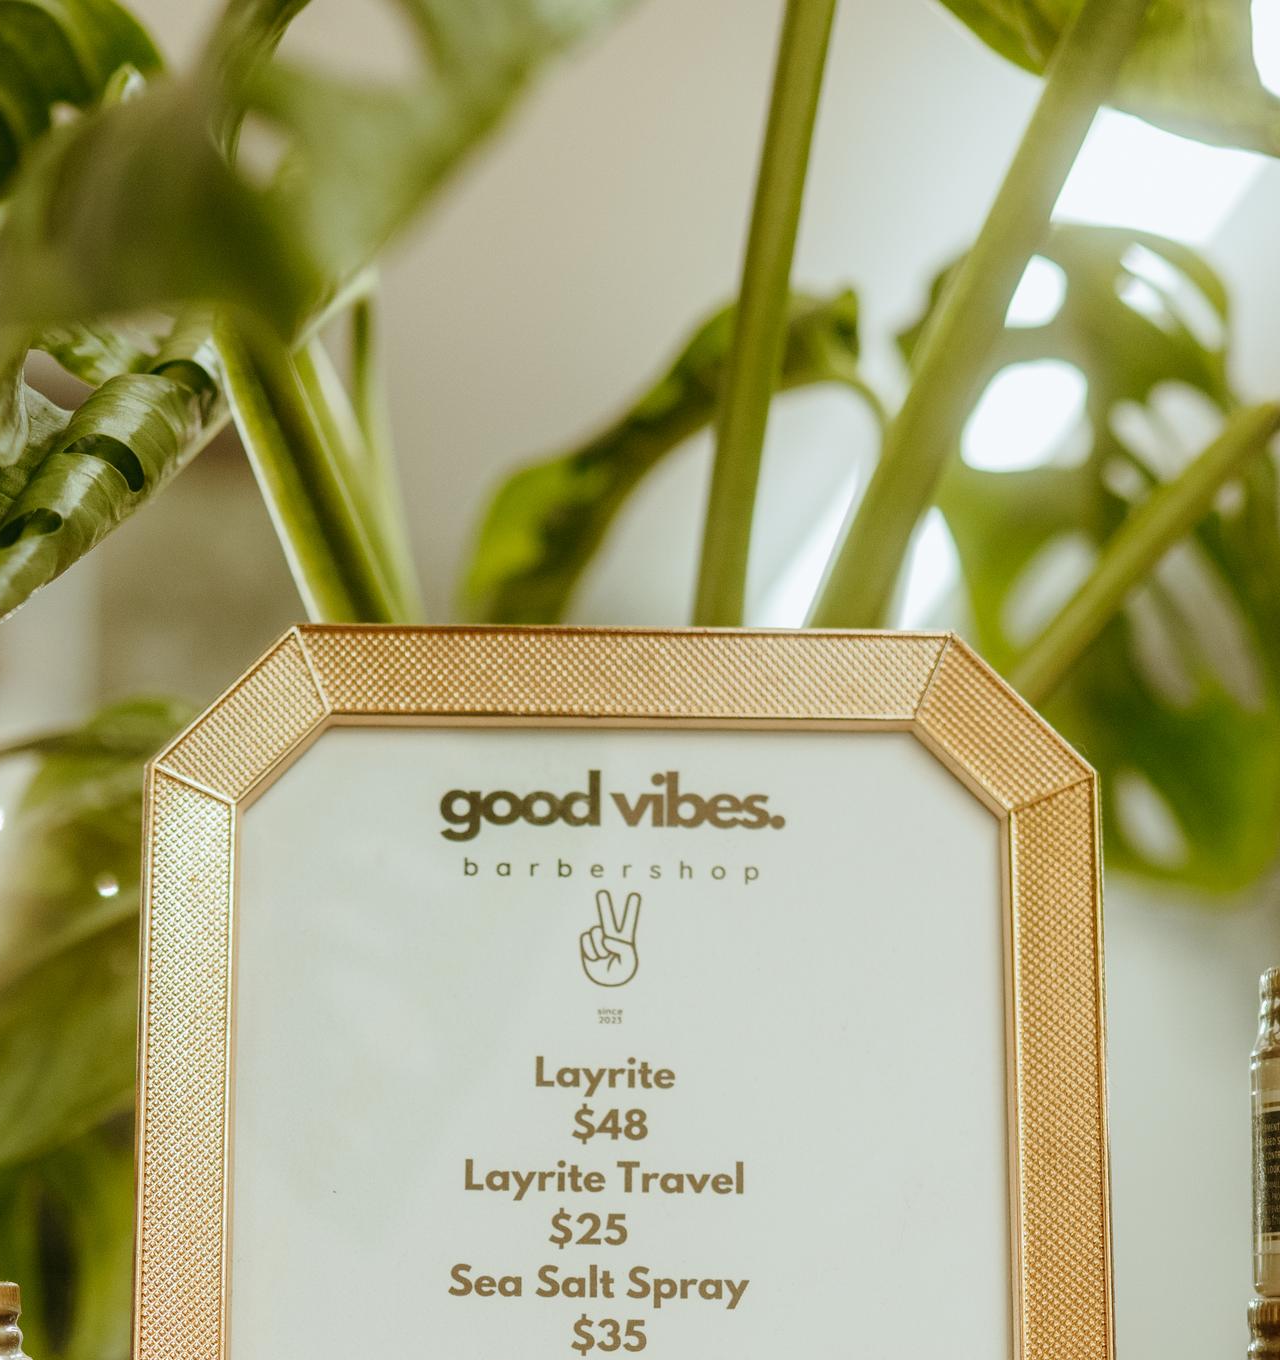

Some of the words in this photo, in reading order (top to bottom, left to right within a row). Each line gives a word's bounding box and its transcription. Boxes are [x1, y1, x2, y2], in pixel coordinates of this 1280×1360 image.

[440, 770, 601, 842] good
[609, 771, 786, 830] vibes.
[464, 857, 760, 885] barbershop
[535, 1055, 676, 1097] Layrite
[572, 1103, 648, 1145] $48
[464, 1158, 606, 1201] Layrite
[617, 1160, 744, 1195] Travel
[548, 1207, 628, 1250] $25
[447, 1263, 522, 1297] Sea
[535, 1264, 615, 1298] Salt
[626, 1265, 750, 1310] Spray
[571, 1313, 647, 1356] $35
